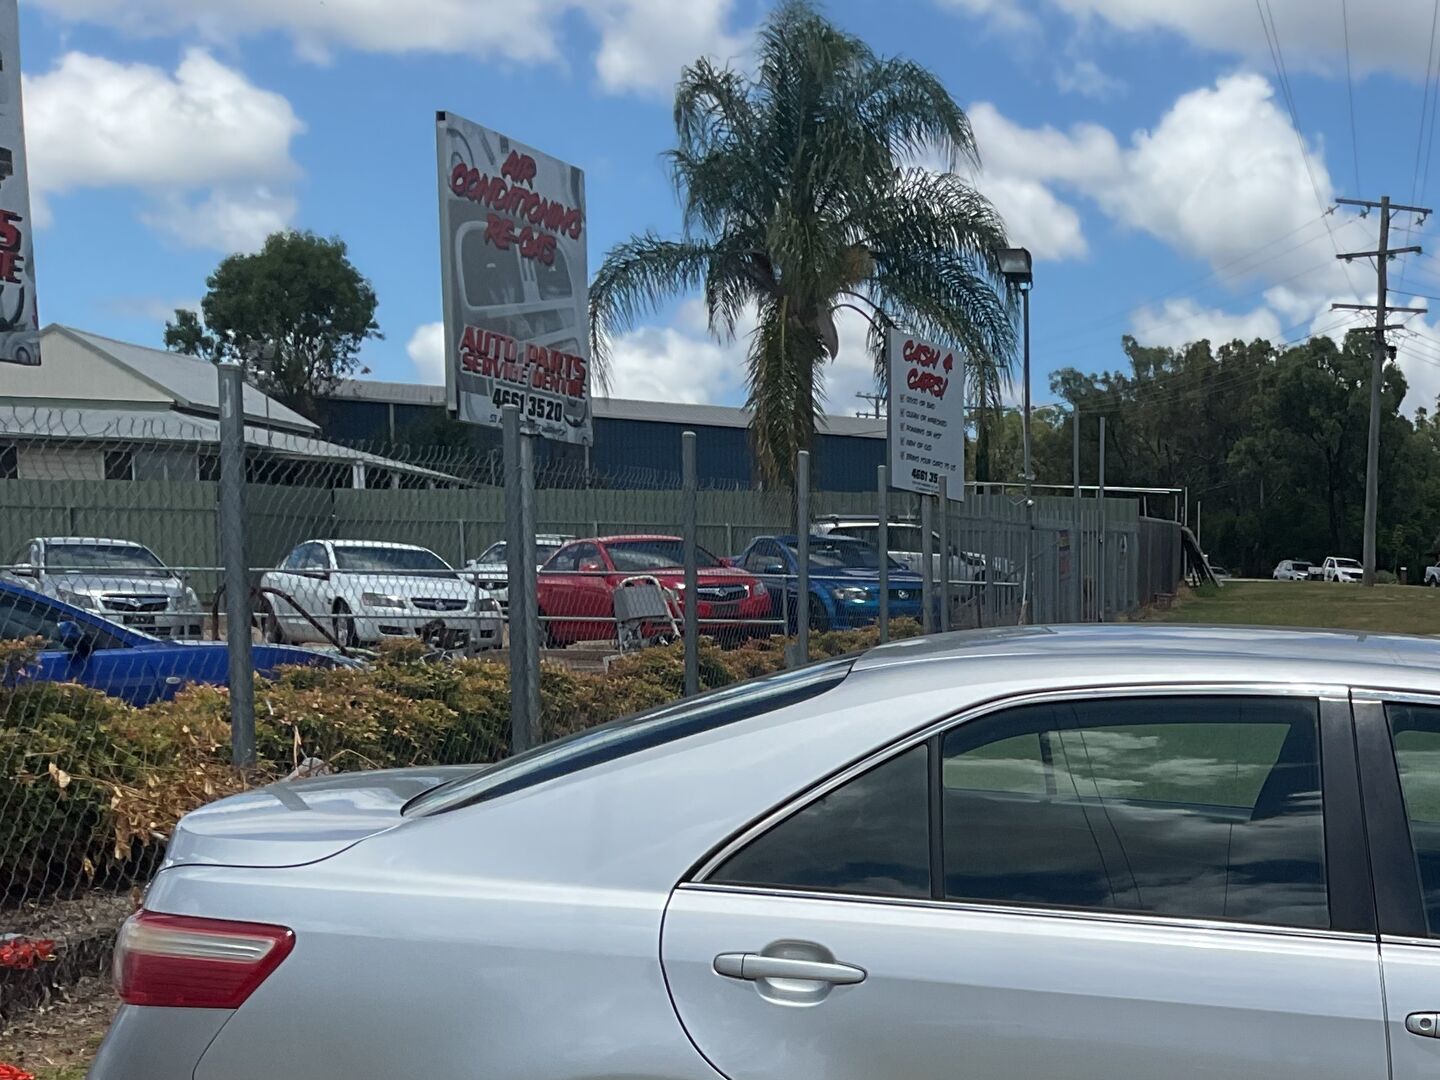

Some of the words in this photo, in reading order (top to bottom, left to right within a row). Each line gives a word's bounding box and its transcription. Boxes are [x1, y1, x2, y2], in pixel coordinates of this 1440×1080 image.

[501, 149, 537, 190] AIR
[451, 162, 583, 240] CONDITIONING
[484, 212, 557, 267] RE-GAS
[460, 326, 518, 364] AUTO
[525, 342, 587, 381] PARTS
[903, 339, 941, 370] CASH
[462, 352, 527, 385] SERVICE
[531, 370, 587, 400] CENTRE
[492, 387, 525, 414] 4661
[527, 396, 563, 422] 3520
[911, 468, 928, 481] 4661
[929, 472, 939, 483] 35
